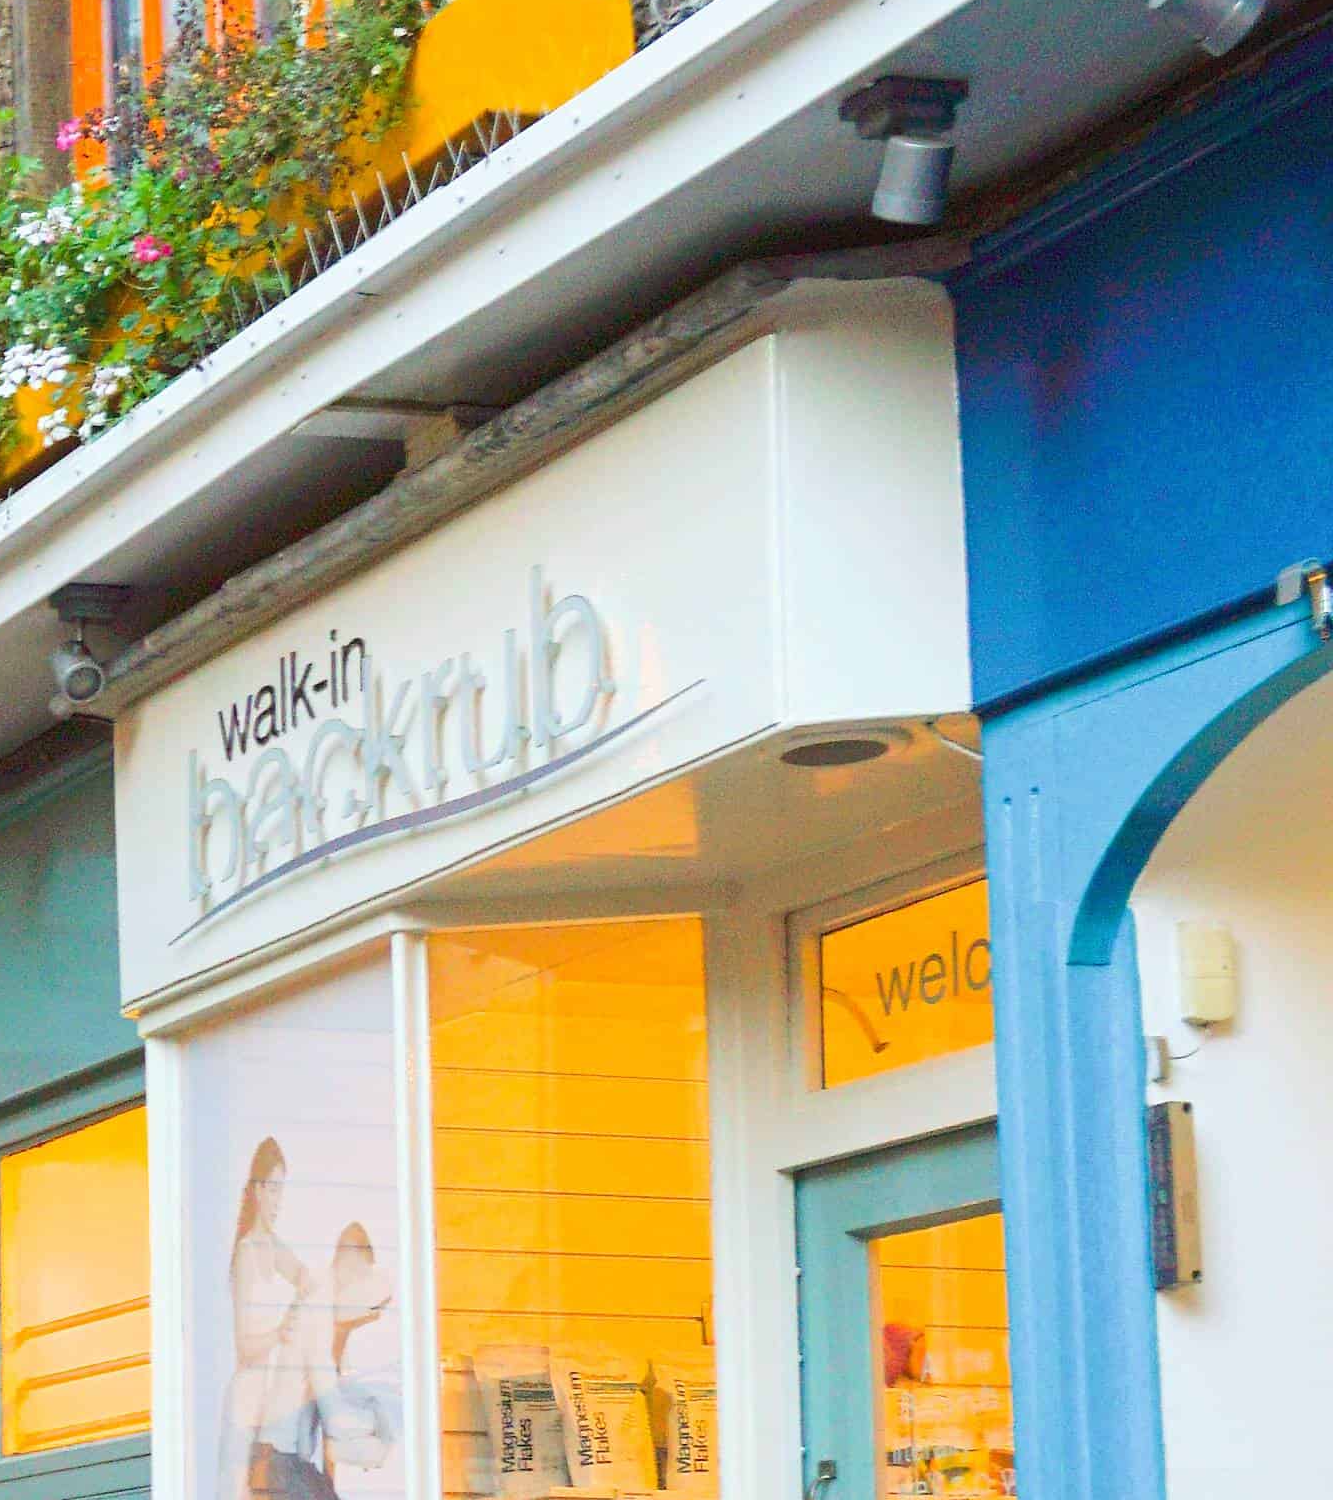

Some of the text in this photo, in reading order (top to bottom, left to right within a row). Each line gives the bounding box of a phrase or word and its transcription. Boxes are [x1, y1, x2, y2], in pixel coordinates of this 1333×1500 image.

[187, 564, 619, 902] backrub
[217, 630, 367, 762] walk-in
[501, 1380, 516, 1473] Magnesium
[517, 1418, 533, 1472] Flakes
[569, 1372, 594, 1467] Magnesium
[595, 1412, 612, 1464] Flakes
[674, 1379, 691, 1474] Magnesium
[694, 1419, 709, 1472] Flakes
